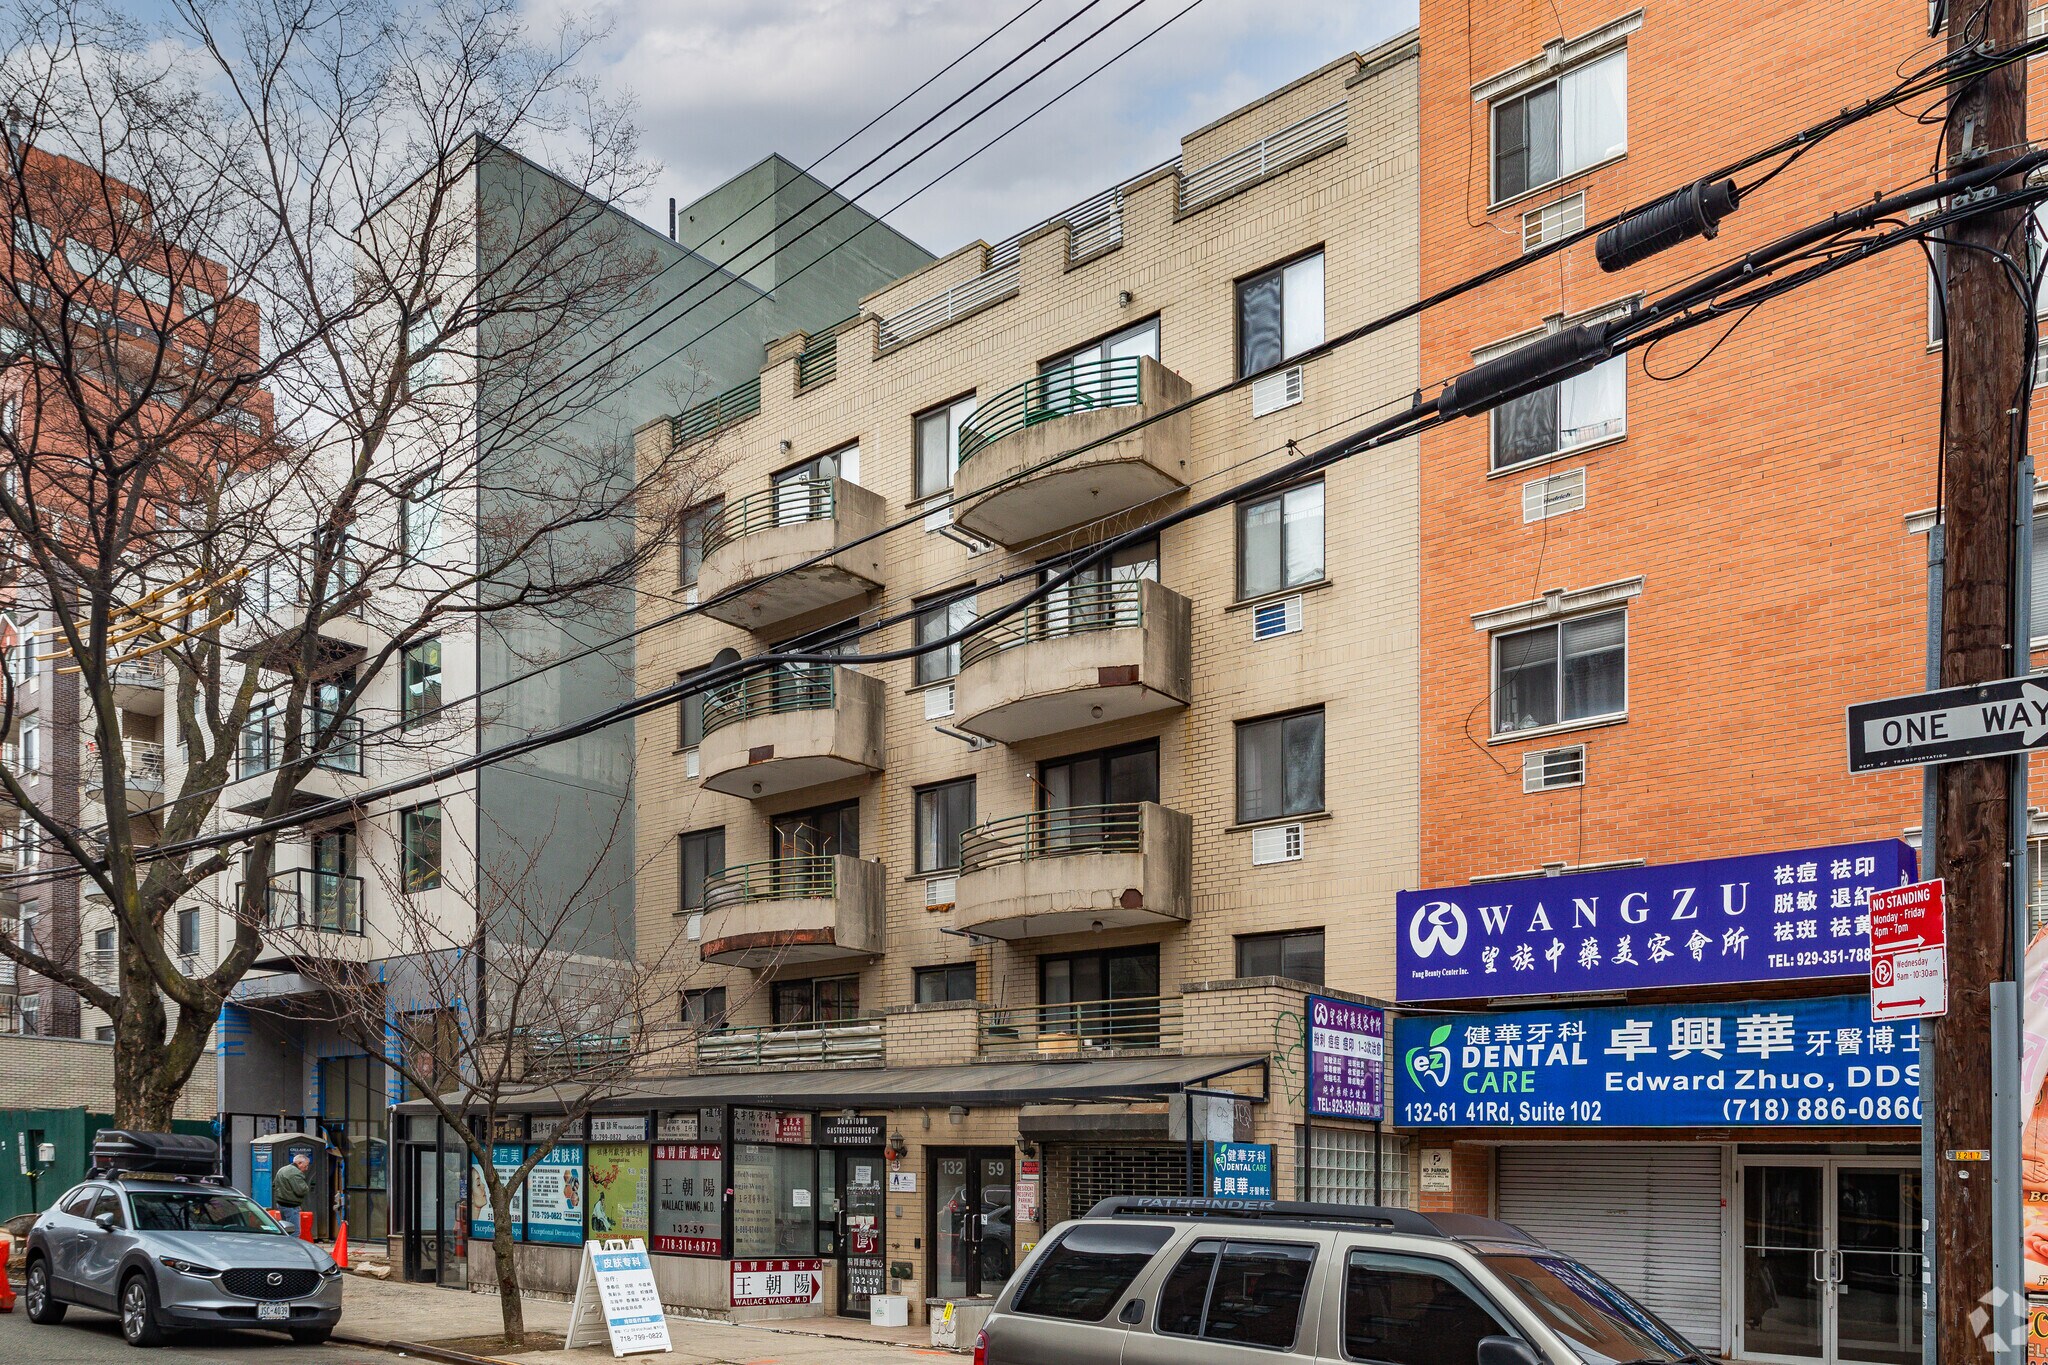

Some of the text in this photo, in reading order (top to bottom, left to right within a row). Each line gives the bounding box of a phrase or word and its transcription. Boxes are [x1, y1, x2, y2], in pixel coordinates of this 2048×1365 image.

[1882, 700, 2048, 747] ONE WAY
[1893, 753, 1948, 765] TRANSPORTATION
[1872, 888, 1930, 911] NO STANDING
[1477, 882, 1750, 936] WANGZU
[1873, 912, 1899, 926] Monday
[1904, 906, 1926, 920] Friday
[1874, 926, 1889, 939] 4pm
[1894, 923, 1909, 935] 7pm
[1768, 948, 1871, 969] TEL: 929-351-788
[1896, 957, 1929, 969] Wednesday
[1425, 968, 1442, 979] Beauty
[1442, 967, 1459, 977] Center
[1459, 967, 1469, 976] Inc.
[1464, 1020, 1587, 1046] 健華牙科
[1603, 1012, 1796, 1061] 卓興華
[1805, 1025, 1921, 1057] 牙醫博士
[1461, 1042, 1588, 1069] DENTAL
[1462, 1070, 1536, 1094] CARE
[1605, 1064, 1920, 1093] Edward Zhuo, DDS
[1317, 1097, 1331, 1113] TEL:
[1722, 1097, 1790, 1121] (718)
[1404, 1100, 1603, 1126] 132-61 41Rd, Suite 102
[826, 1126, 879, 1134] GASTROENTEROLOGY
[839, 1136, 872, 1144] HEPATOLOGY
[1227, 1149, 1267, 1164] 健華牙科
[942, 1160, 963, 1175] 132
[988, 1162, 1005, 1176] 59
[1226, 1163, 1267, 1172] DENTAL CARE
[661, 1177, 716, 1198] 王朝陽
[661, 1200, 716, 1214] WALLACE WANG, M.D.
[1137, 1198, 1276, 1211] PATHFINDER
[530, 1226, 554, 1236] Exceptional
[672, 1224, 705, 1234] 132-59
[661, 1238, 717, 1251] 718-316-6873
[735, 1273, 810, 1295] 王朝陽
[851, 1276, 880, 1286] 132-59
[853, 1285, 862, 1293] 1A
[869, 1286, 878, 1294] 1B
[734, 1298, 767, 1306] WALLACE
[767, 1297, 793, 1305] WANG,
[620, 1332, 663, 1342] 718-799-0822
